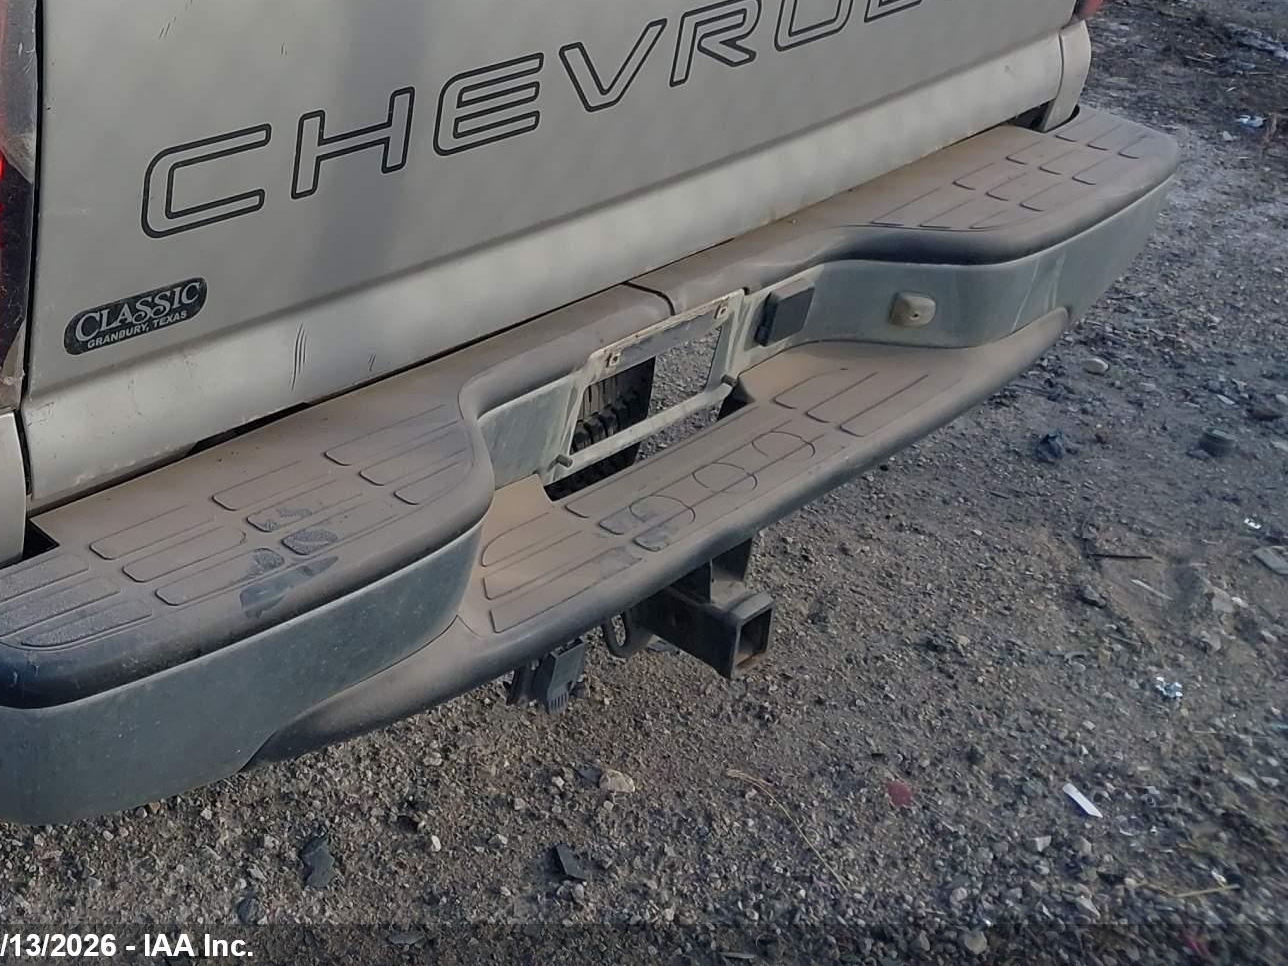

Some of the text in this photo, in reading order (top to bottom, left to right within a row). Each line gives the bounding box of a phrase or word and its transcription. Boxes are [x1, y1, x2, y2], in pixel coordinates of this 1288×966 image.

[75, 282, 201, 342] CLASSIC
[87, 311, 187, 348] GRANBURY, TEXAS
